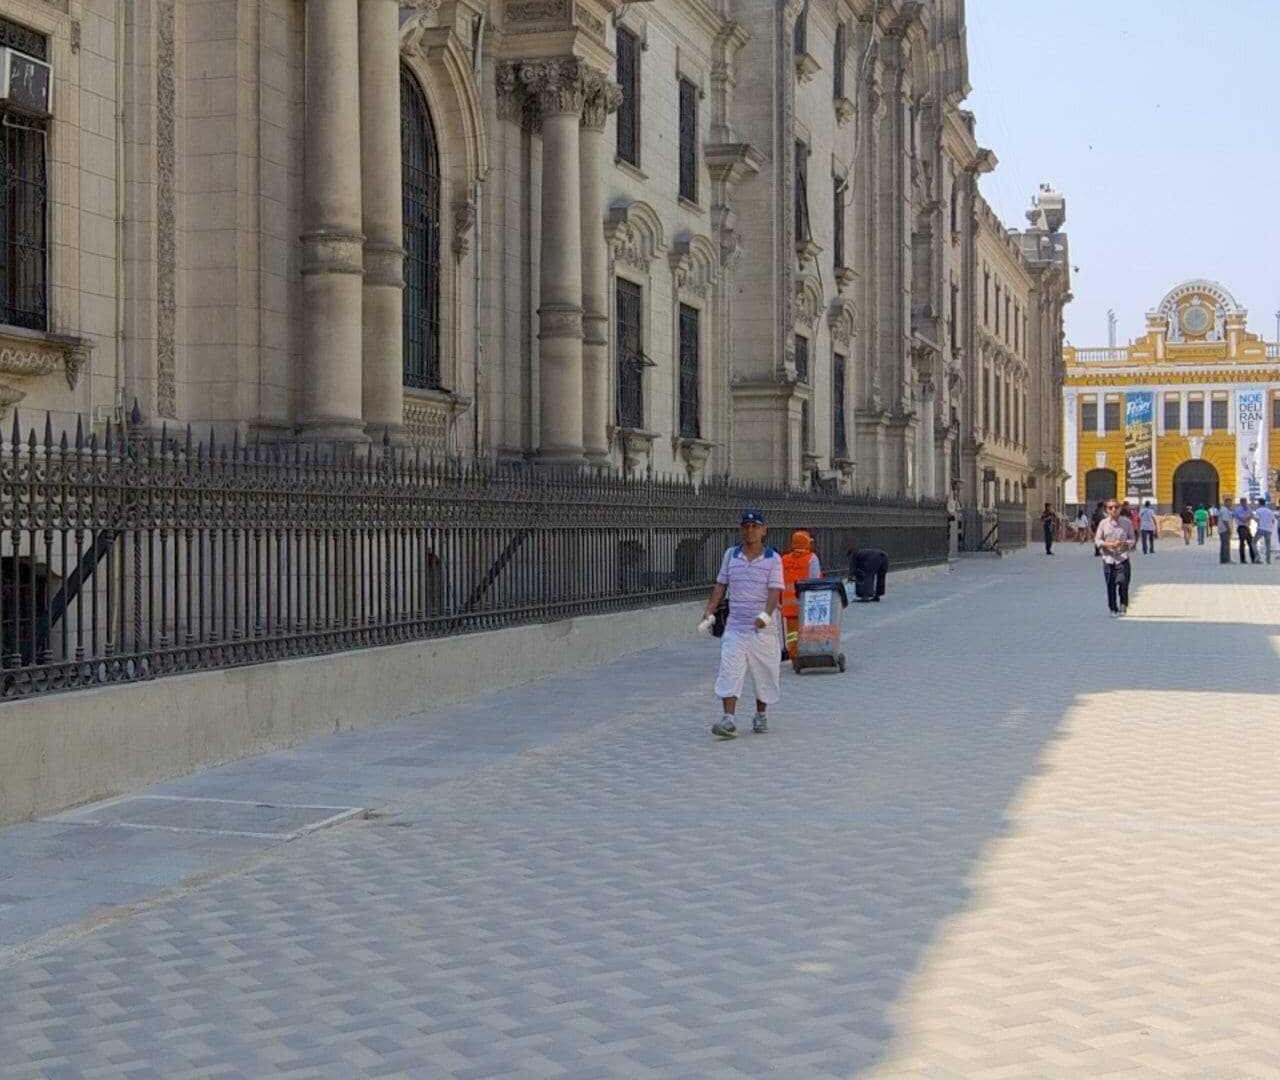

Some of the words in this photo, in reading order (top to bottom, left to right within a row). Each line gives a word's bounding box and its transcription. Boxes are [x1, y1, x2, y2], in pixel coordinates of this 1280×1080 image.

[1182, 374, 1259, 383] LITERATURA
[1239, 392, 1262, 402] NOÉ
[1240, 413, 1263, 421] RAN
[1240, 420, 1255, 429] TE
